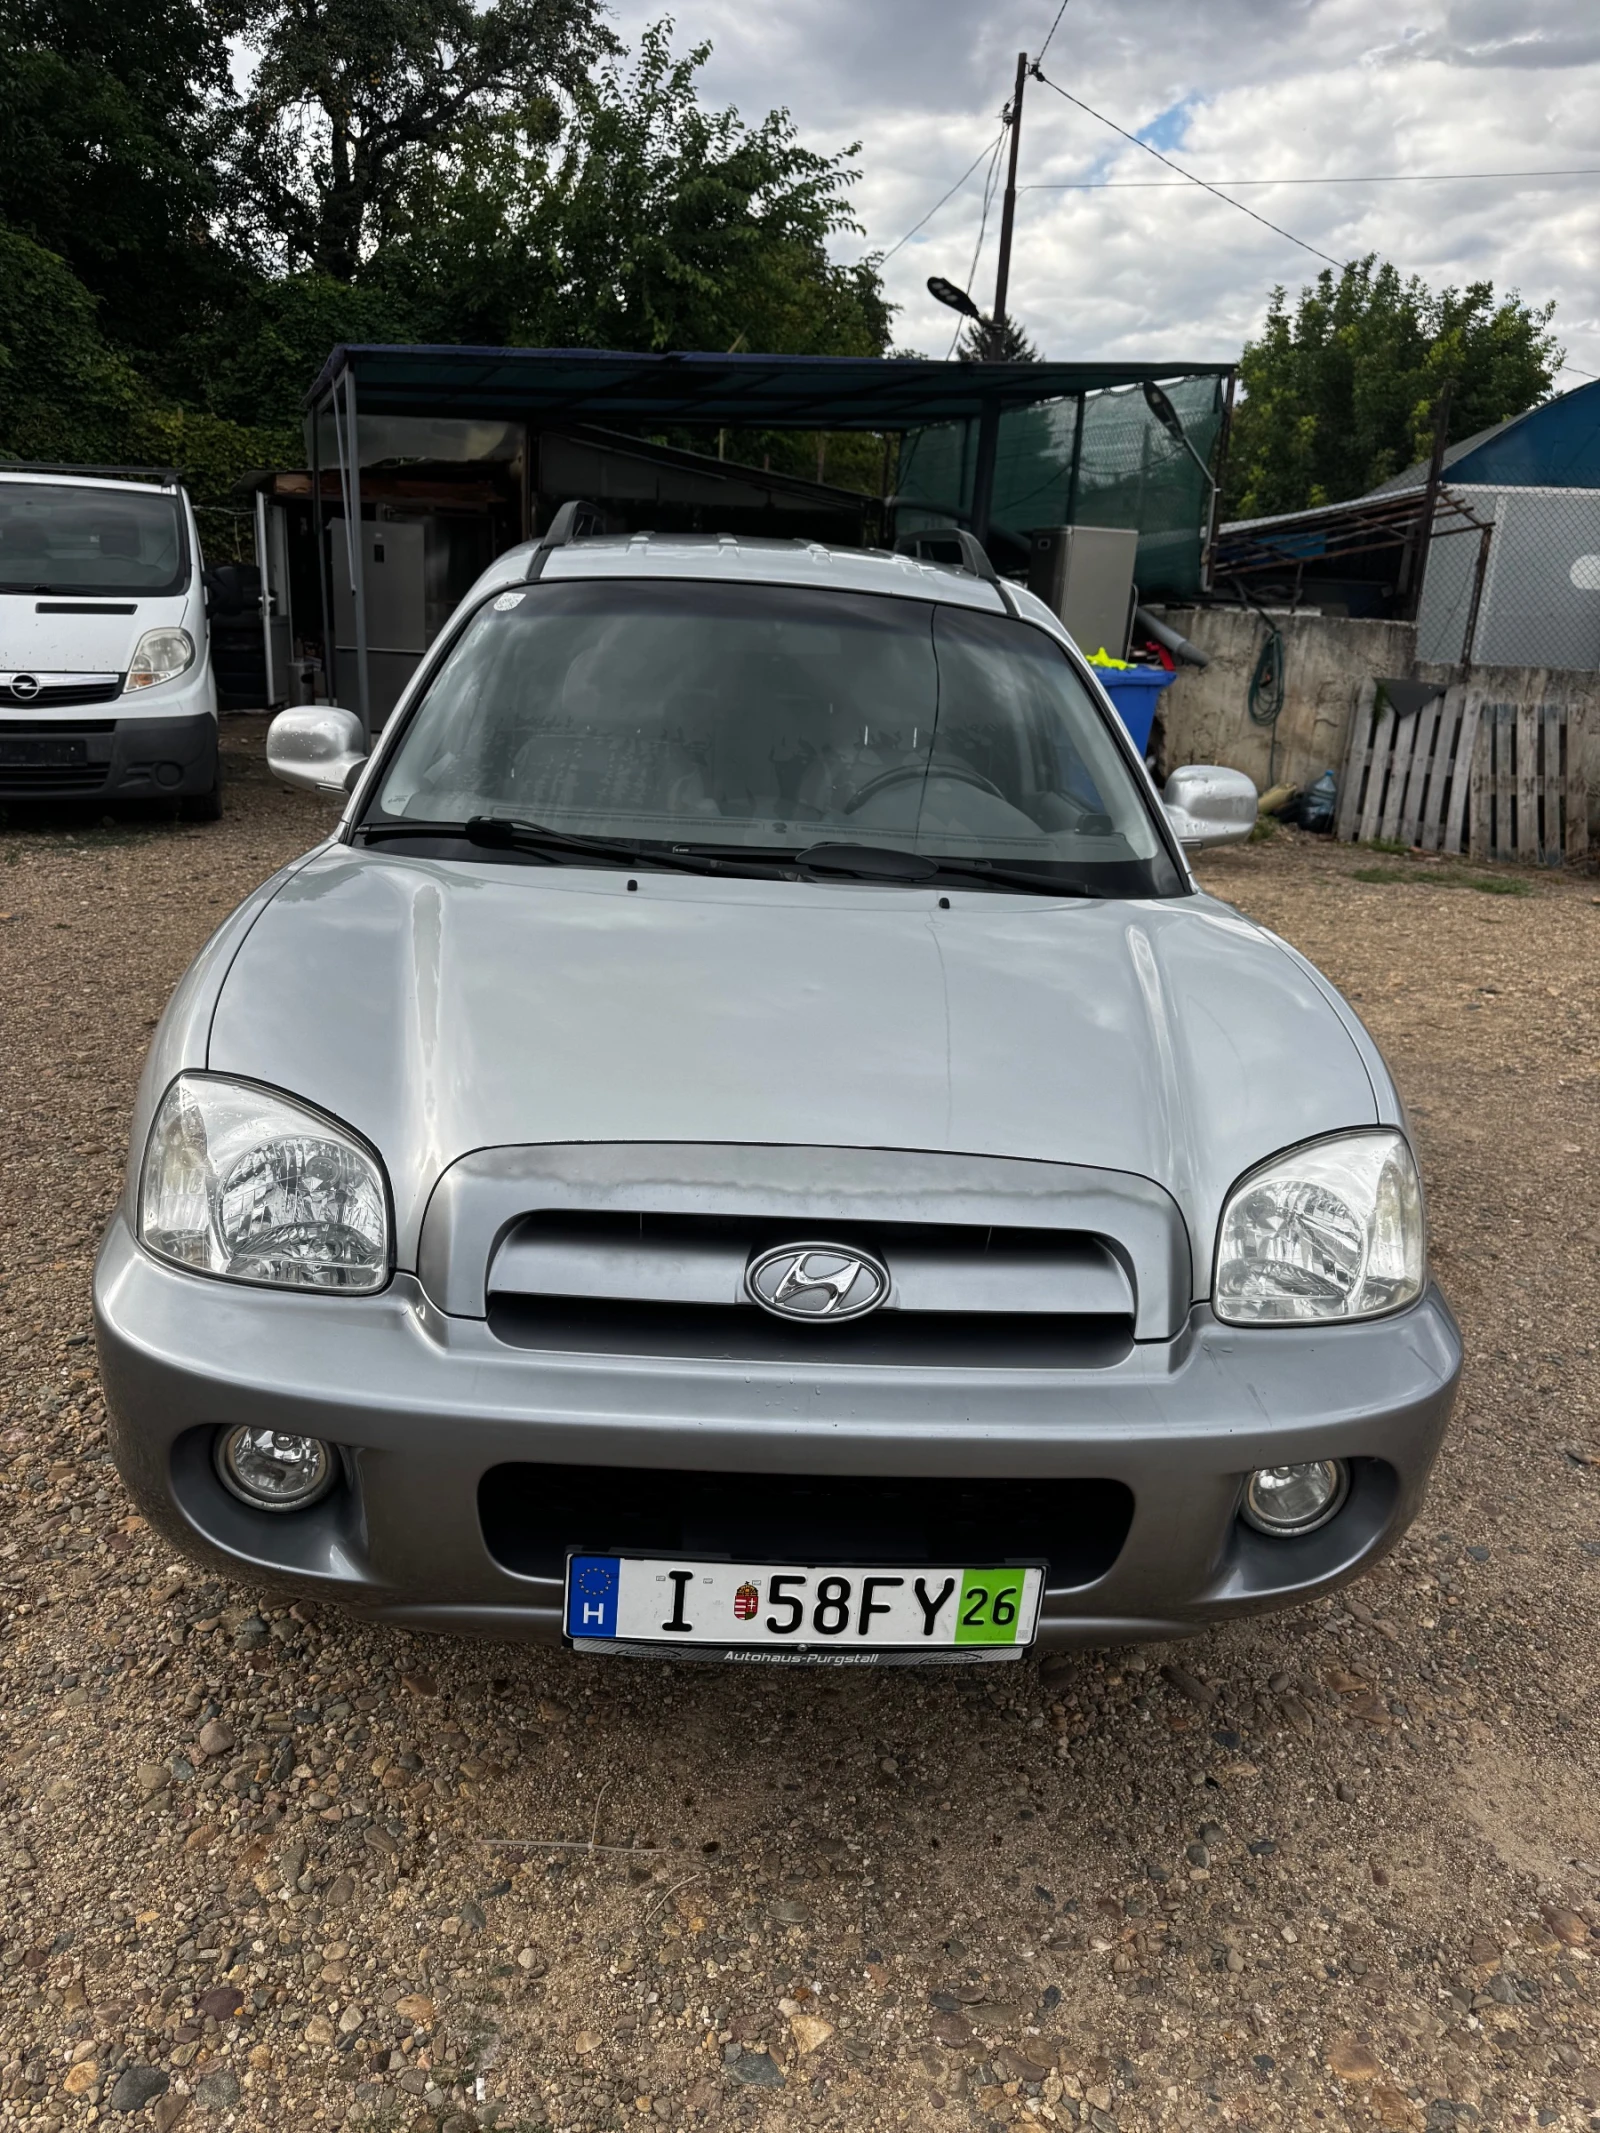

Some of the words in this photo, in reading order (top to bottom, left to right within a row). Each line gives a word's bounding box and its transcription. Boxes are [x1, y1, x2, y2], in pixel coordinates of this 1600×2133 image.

[583, 1602, 604, 1625] H
[662, 1570, 694, 1632] I
[766, 1574, 956, 1636] 58FY
[962, 1587, 1017, 1626] 26
[723, 1651, 879, 1666] Autohaus-Purgstall
